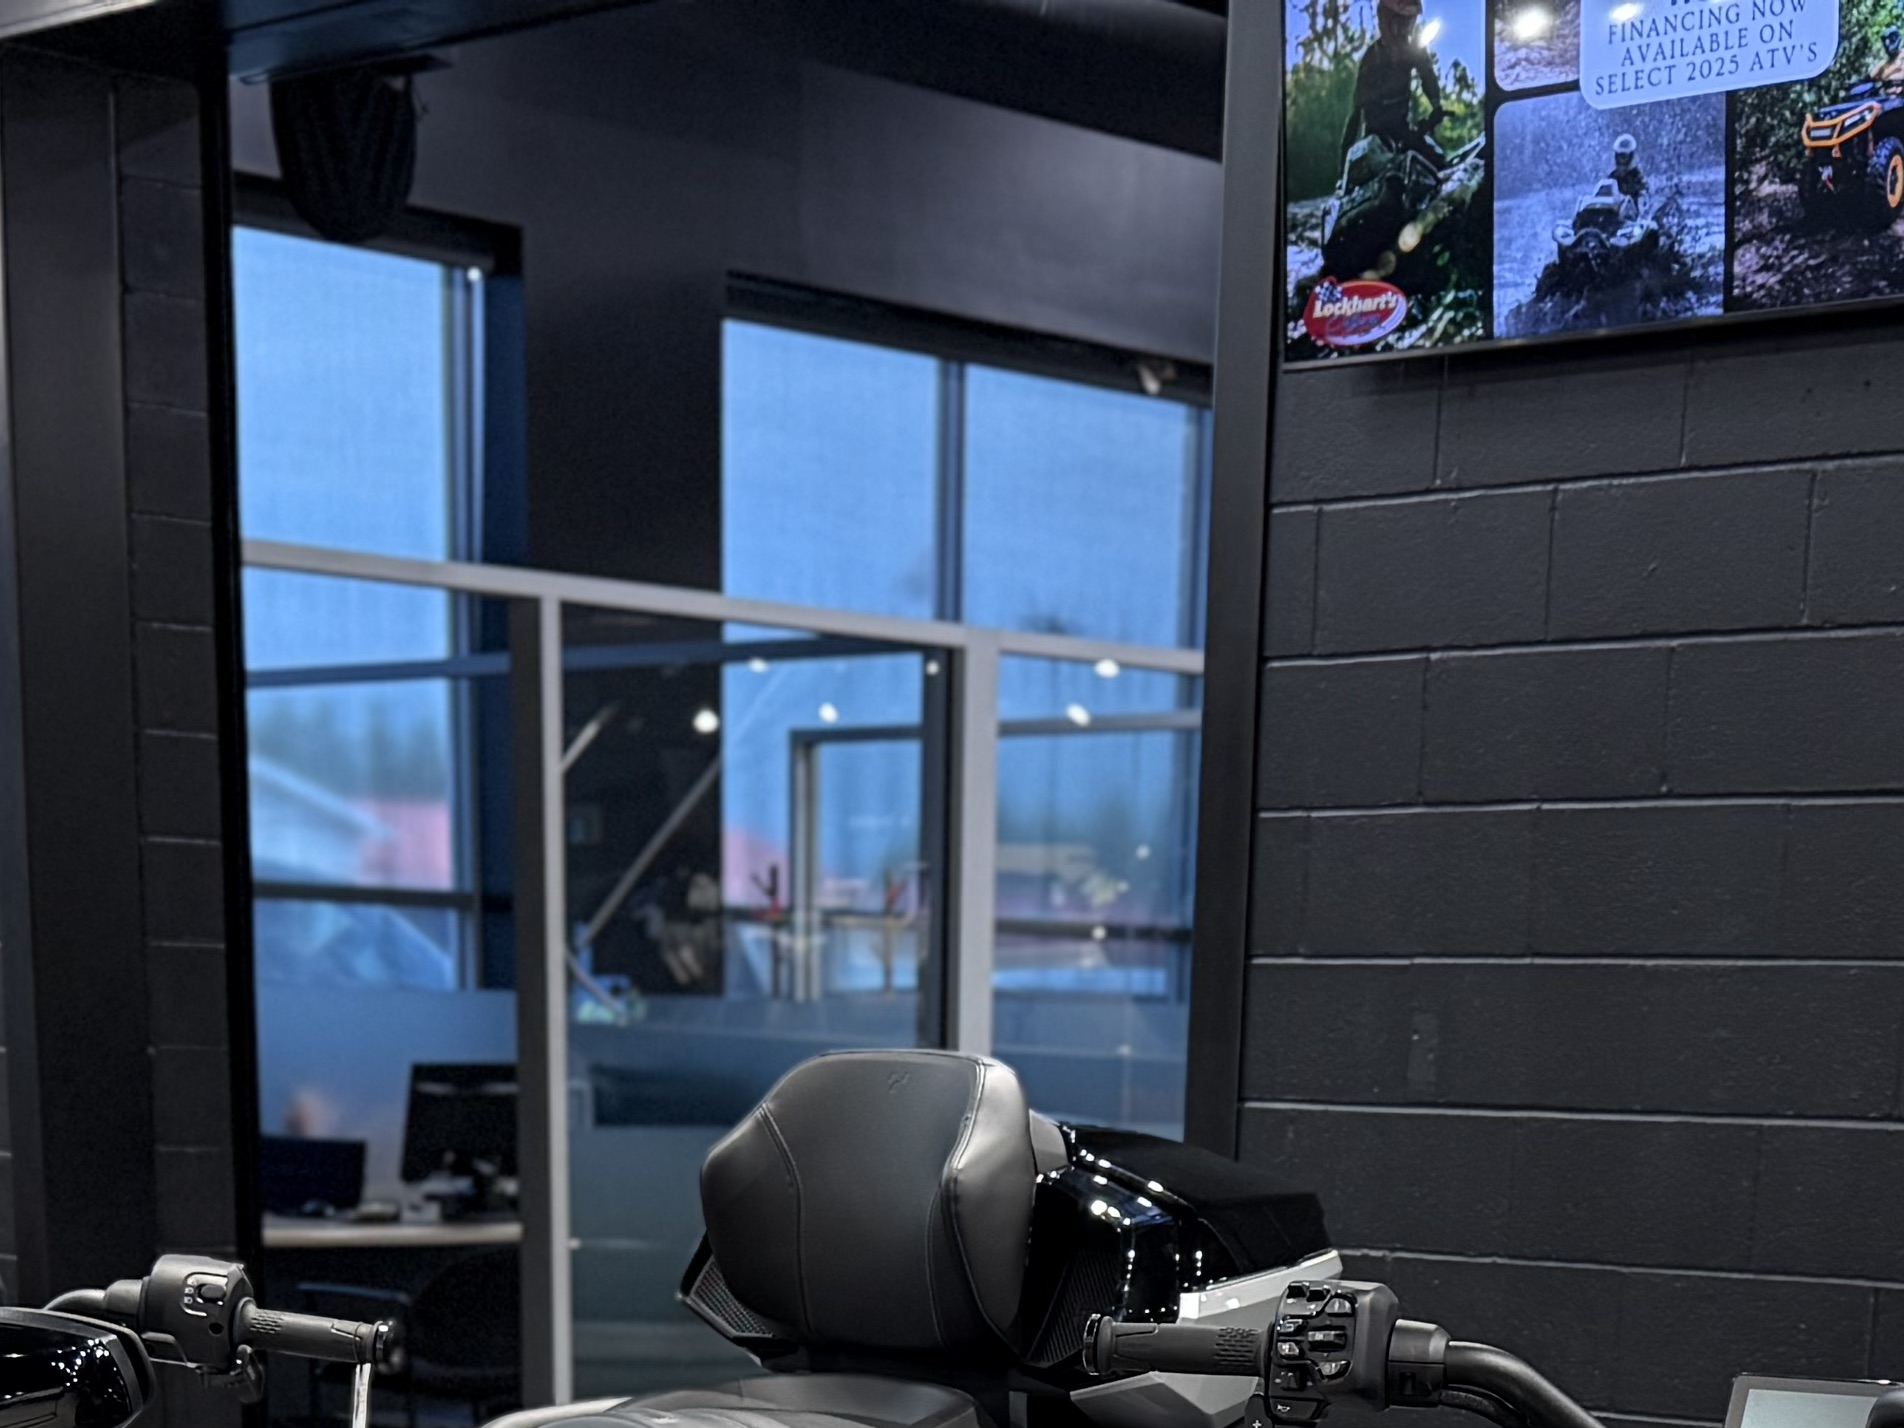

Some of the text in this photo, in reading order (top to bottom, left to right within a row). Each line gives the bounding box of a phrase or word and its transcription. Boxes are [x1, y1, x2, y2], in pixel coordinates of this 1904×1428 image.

[1608, 0, 1807, 45] FINANCING NOW
[1621, 20, 1794, 67] AVAILABLE ON
[1595, 42, 1818, 96] SELECT 2025 ATV'S
